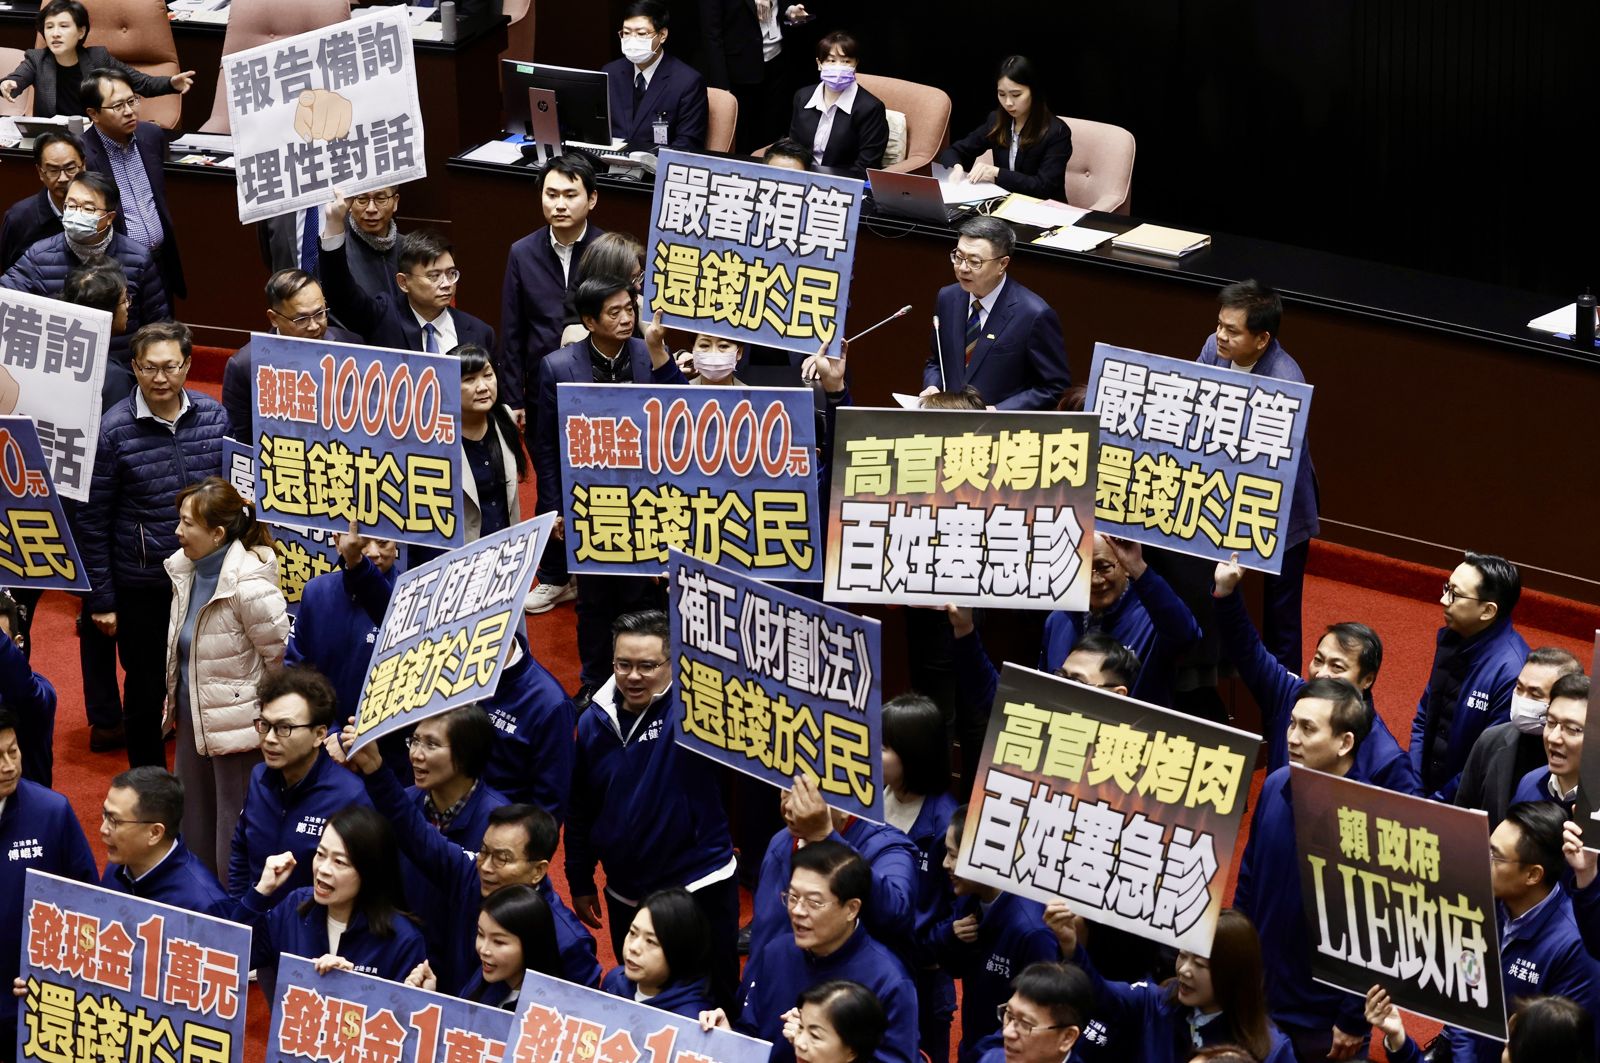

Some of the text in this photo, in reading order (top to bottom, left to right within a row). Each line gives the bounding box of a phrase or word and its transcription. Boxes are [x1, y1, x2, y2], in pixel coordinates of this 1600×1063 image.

[230, 21, 403, 115] 報告備詢
[240, 112, 416, 206] 理性對話
[656, 163, 853, 261] 嚴審預算
[0, 302, 98, 382] 備詢
[651, 241, 841, 345] 還錢於民
[256, 354, 455, 444] 發現金10000元
[565, 398, 811, 478] 發現金10000元
[1095, 359, 1300, 468] 嚴審預算
[258, 432, 456, 538] 還錢於民
[843, 428, 1090, 497] 高官爽烤肉
[1095, 443, 1284, 559] 還錢於民
[571, 482, 814, 572] 還錢於民
[836, 501, 1085, 600] 百姓塞急診
[378, 528, 540, 654] 補正《財劃法》
[677, 565, 874, 713] 補正《財劃法》
[355, 610, 512, 739] 還錢於民
[679, 653, 875, 808] 還錢於民
[992, 702, 1246, 815] 高官爽烤肉
[968, 768, 1219, 938] 百姓塞急診
[1376, 815, 1441, 883] 政府
[278, 983, 508, 1063] 發現金1
